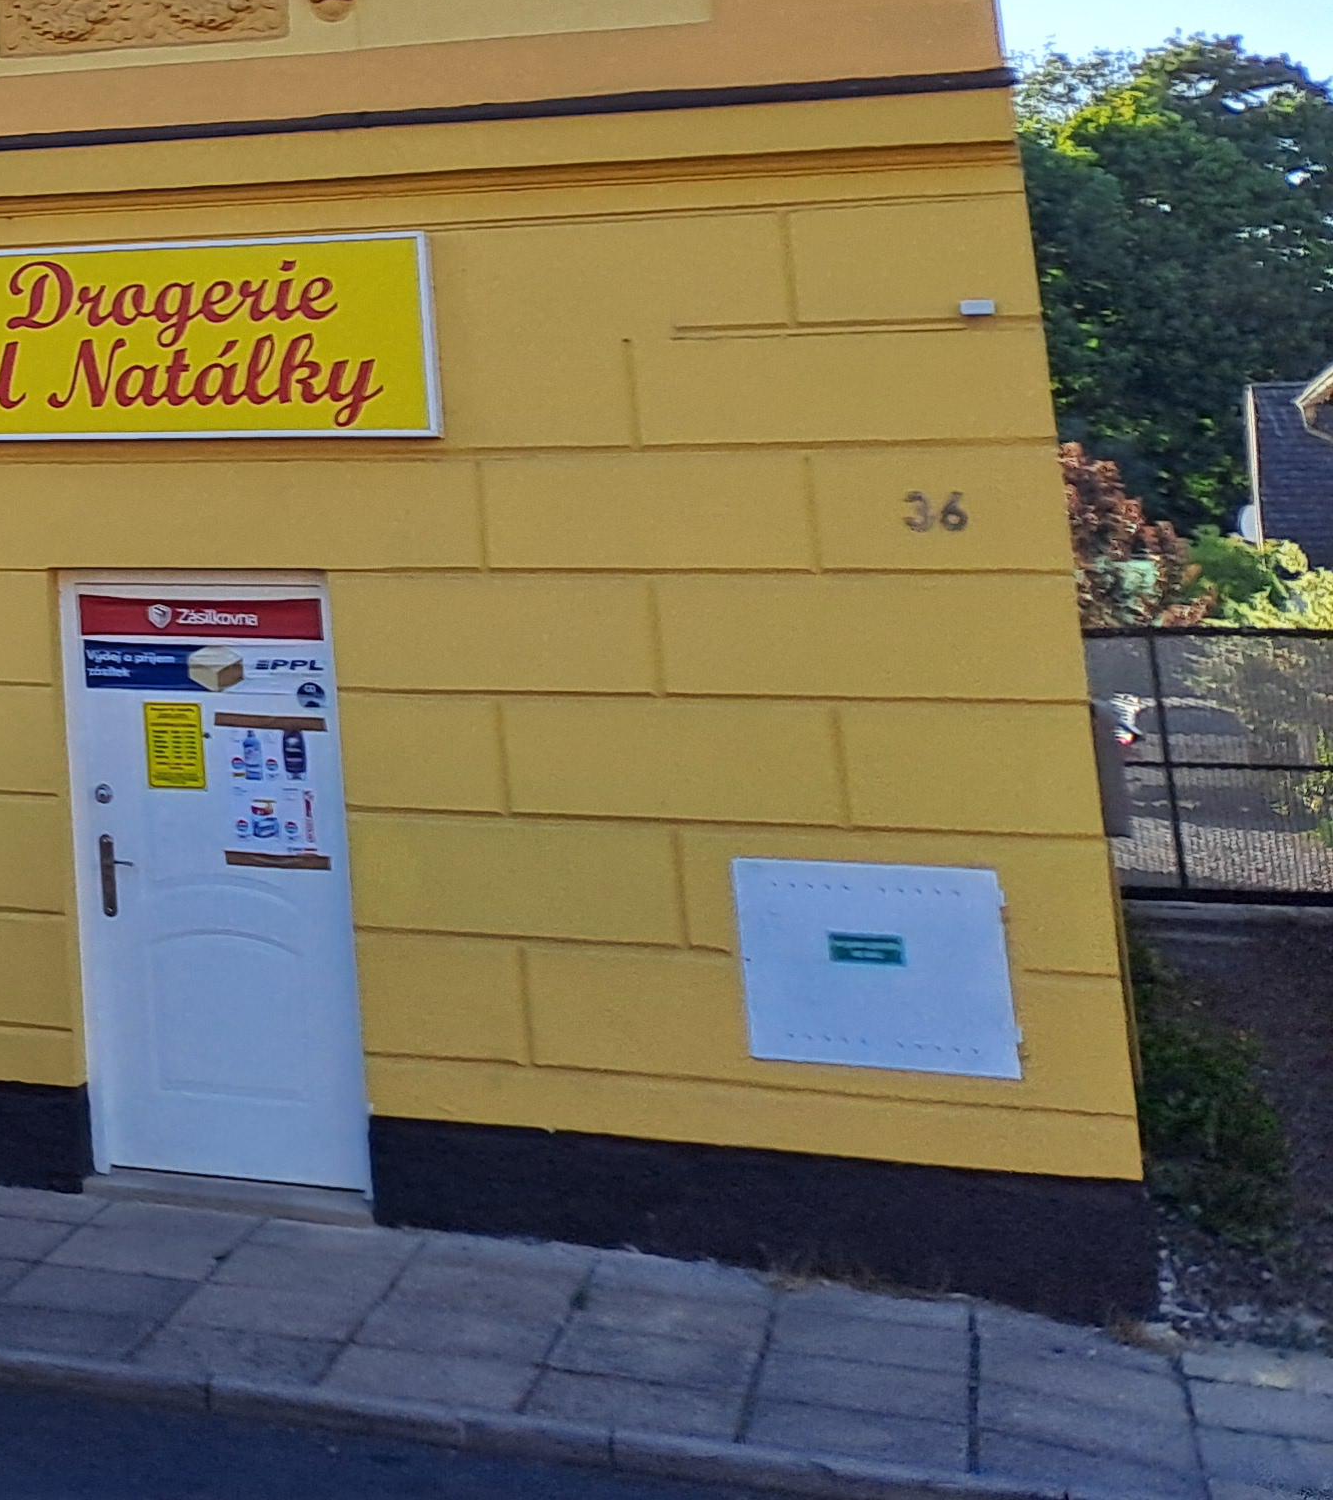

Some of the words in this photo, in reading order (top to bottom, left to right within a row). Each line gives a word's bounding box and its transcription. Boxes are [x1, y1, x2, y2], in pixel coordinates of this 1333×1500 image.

[5, 259, 338, 348] Drogerie
[47, 332, 384, 428] Natálky
[902, 490, 969, 532] 36
[175, 608, 259, 627] Zásilkovna
